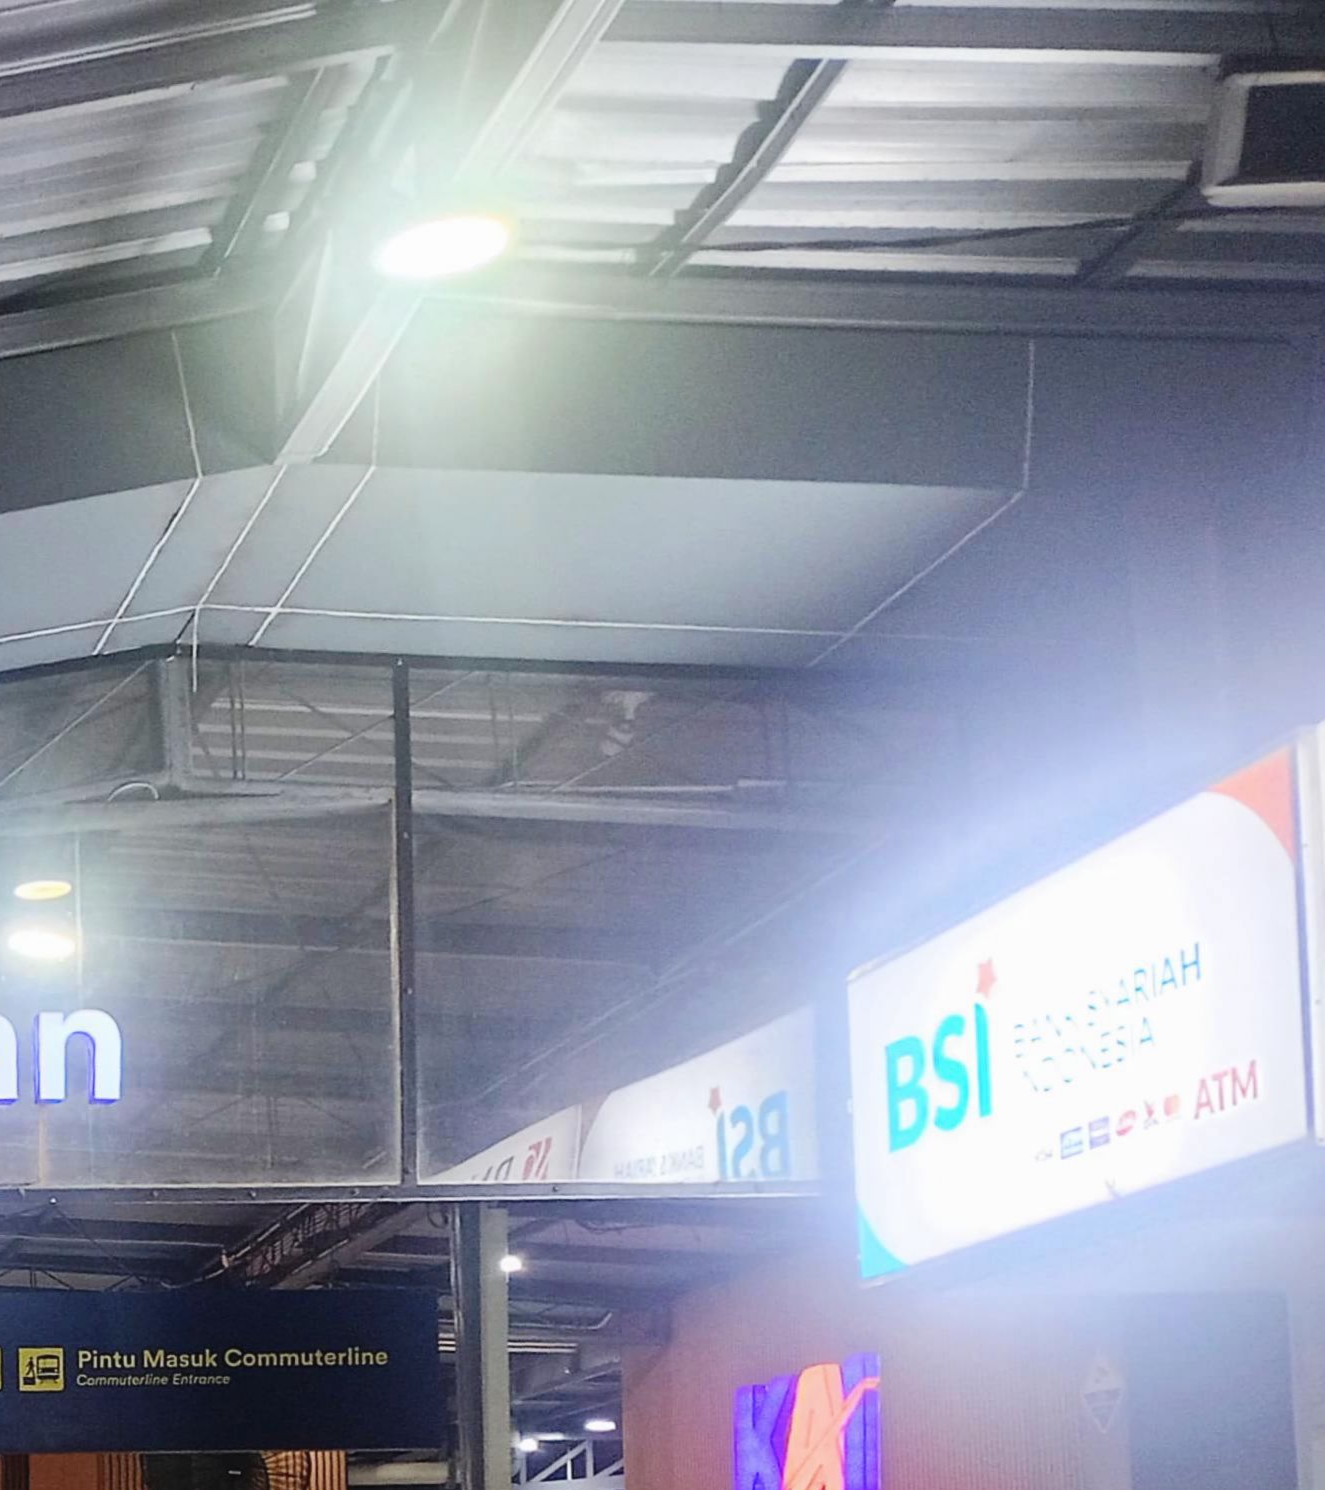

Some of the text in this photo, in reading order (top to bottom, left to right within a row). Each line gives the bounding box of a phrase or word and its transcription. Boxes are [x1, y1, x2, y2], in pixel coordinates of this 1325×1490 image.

[884, 985, 992, 1154] BSI
[1194, 1059, 1258, 1120] ATM
[77, 1346, 389, 1369] Pintu Masuk Commuterline
[76, 1373, 231, 1386] Commuterline Entrance
